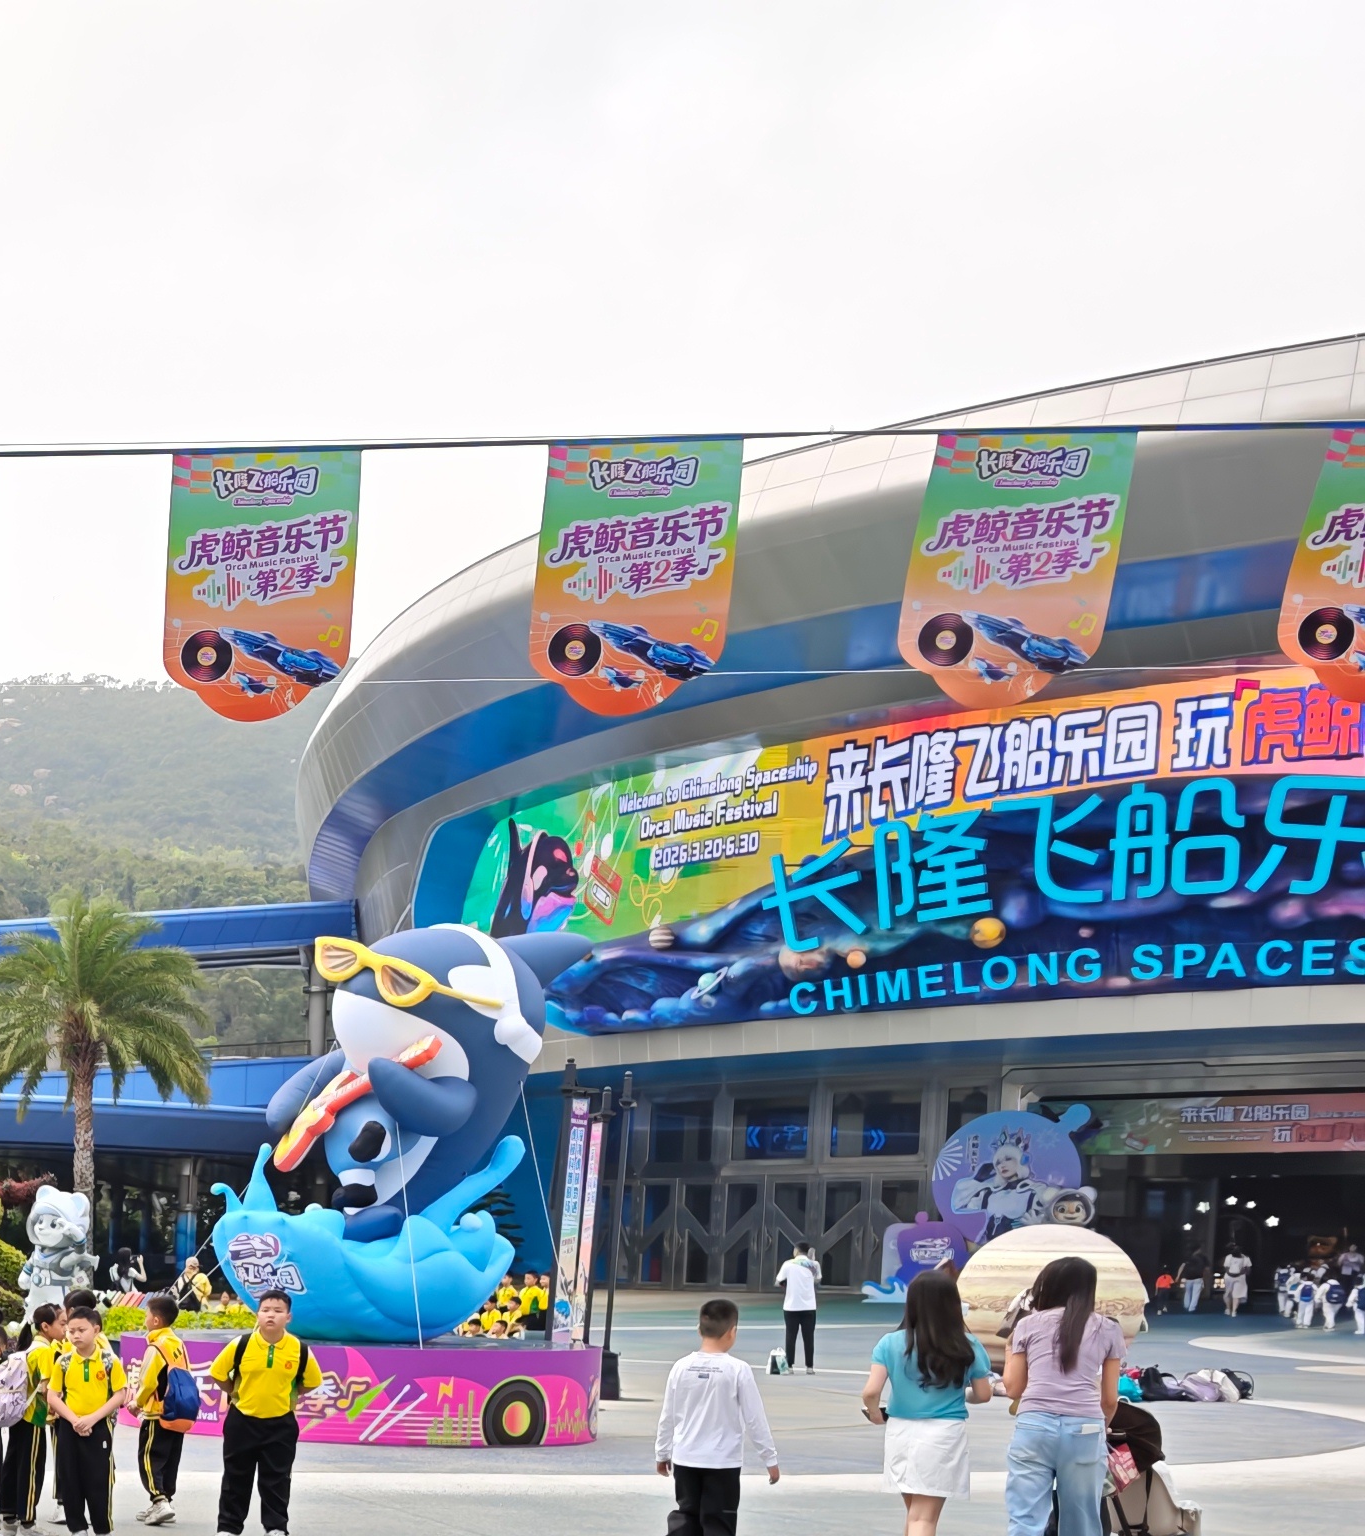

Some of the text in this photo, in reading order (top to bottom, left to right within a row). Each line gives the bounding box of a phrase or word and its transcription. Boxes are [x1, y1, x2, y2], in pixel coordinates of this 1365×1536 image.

[216, 467, 318, 497] 长隆飞船乐园
[591, 458, 697, 488] 长隆飞船乐园
[979, 449, 1089, 478] 长隆飞船乐园
[179, 514, 347, 570] 虎鲸音乐节
[550, 506, 727, 563] 虎鲸音乐节
[926, 498, 1115, 551] 虎鲸音乐节
[249, 559, 277, 569] Music
[280, 555, 319, 565] Festival
[623, 551, 652, 561] Music
[655, 546, 696, 557] Festival
[1002, 541, 1033, 551] Music
[1036, 539, 1079, 549] Festival
[249, 562, 322, 601] 第2季
[621, 554, 699, 594] 第2季
[1000, 546, 1081, 586] 第2季
[619, 757, 818, 815] Welcome to Chimelong Spaceship
[825, 704, 1161, 840] 来长隆飞船乐园
[640, 793, 778, 839] Orca Music Festival
[762, 775, 1365, 953] 长隆飞船乐
[789, 947, 1102, 1016] CHIMELONG
